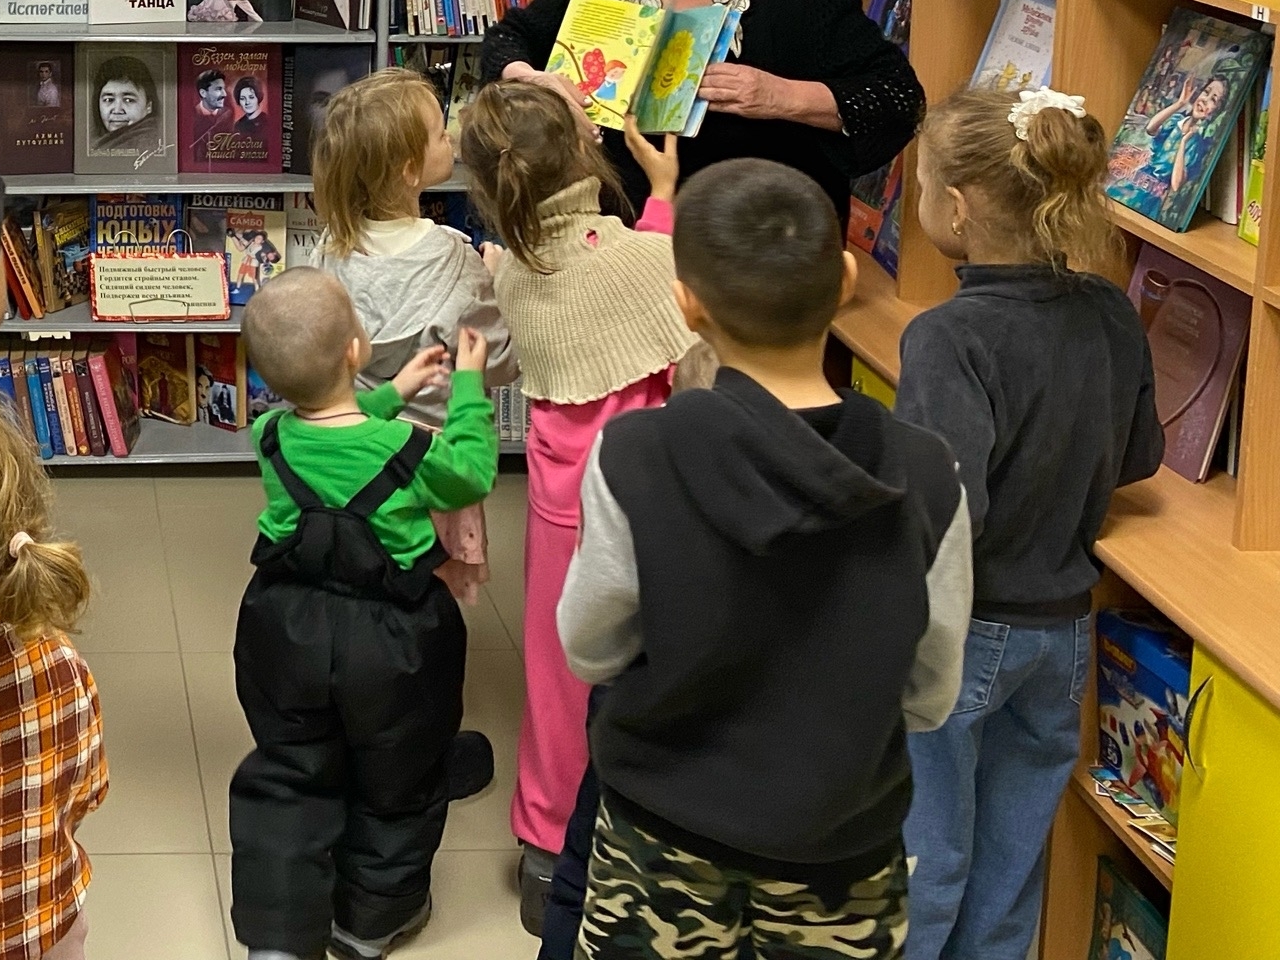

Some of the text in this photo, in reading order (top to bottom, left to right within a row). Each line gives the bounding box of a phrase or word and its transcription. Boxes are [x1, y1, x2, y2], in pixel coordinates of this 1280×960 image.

[128, 0, 175, 10] ТАНЦА
[238, 52, 270, 66] заман
[206, 132, 264, 151] Мелодии
[206, 149, 269, 160] нашей эпохи
[192, 194, 276, 210] ВОЛЕЙБОЛ
[96, 204, 176, 218] ПОДГОТОВКА
[230, 218, 264, 228] САМБО
[96, 220, 176, 244] ЮНЫХ
[99, 266, 144, 274] Подвижный
[144, 266, 178, 274] быстрый
[99, 274, 134, 283] Гордится
[134, 274, 170, 283] стройным
[99, 283, 134, 292] Сидящий
[100, 292, 140, 300] Подвержен
